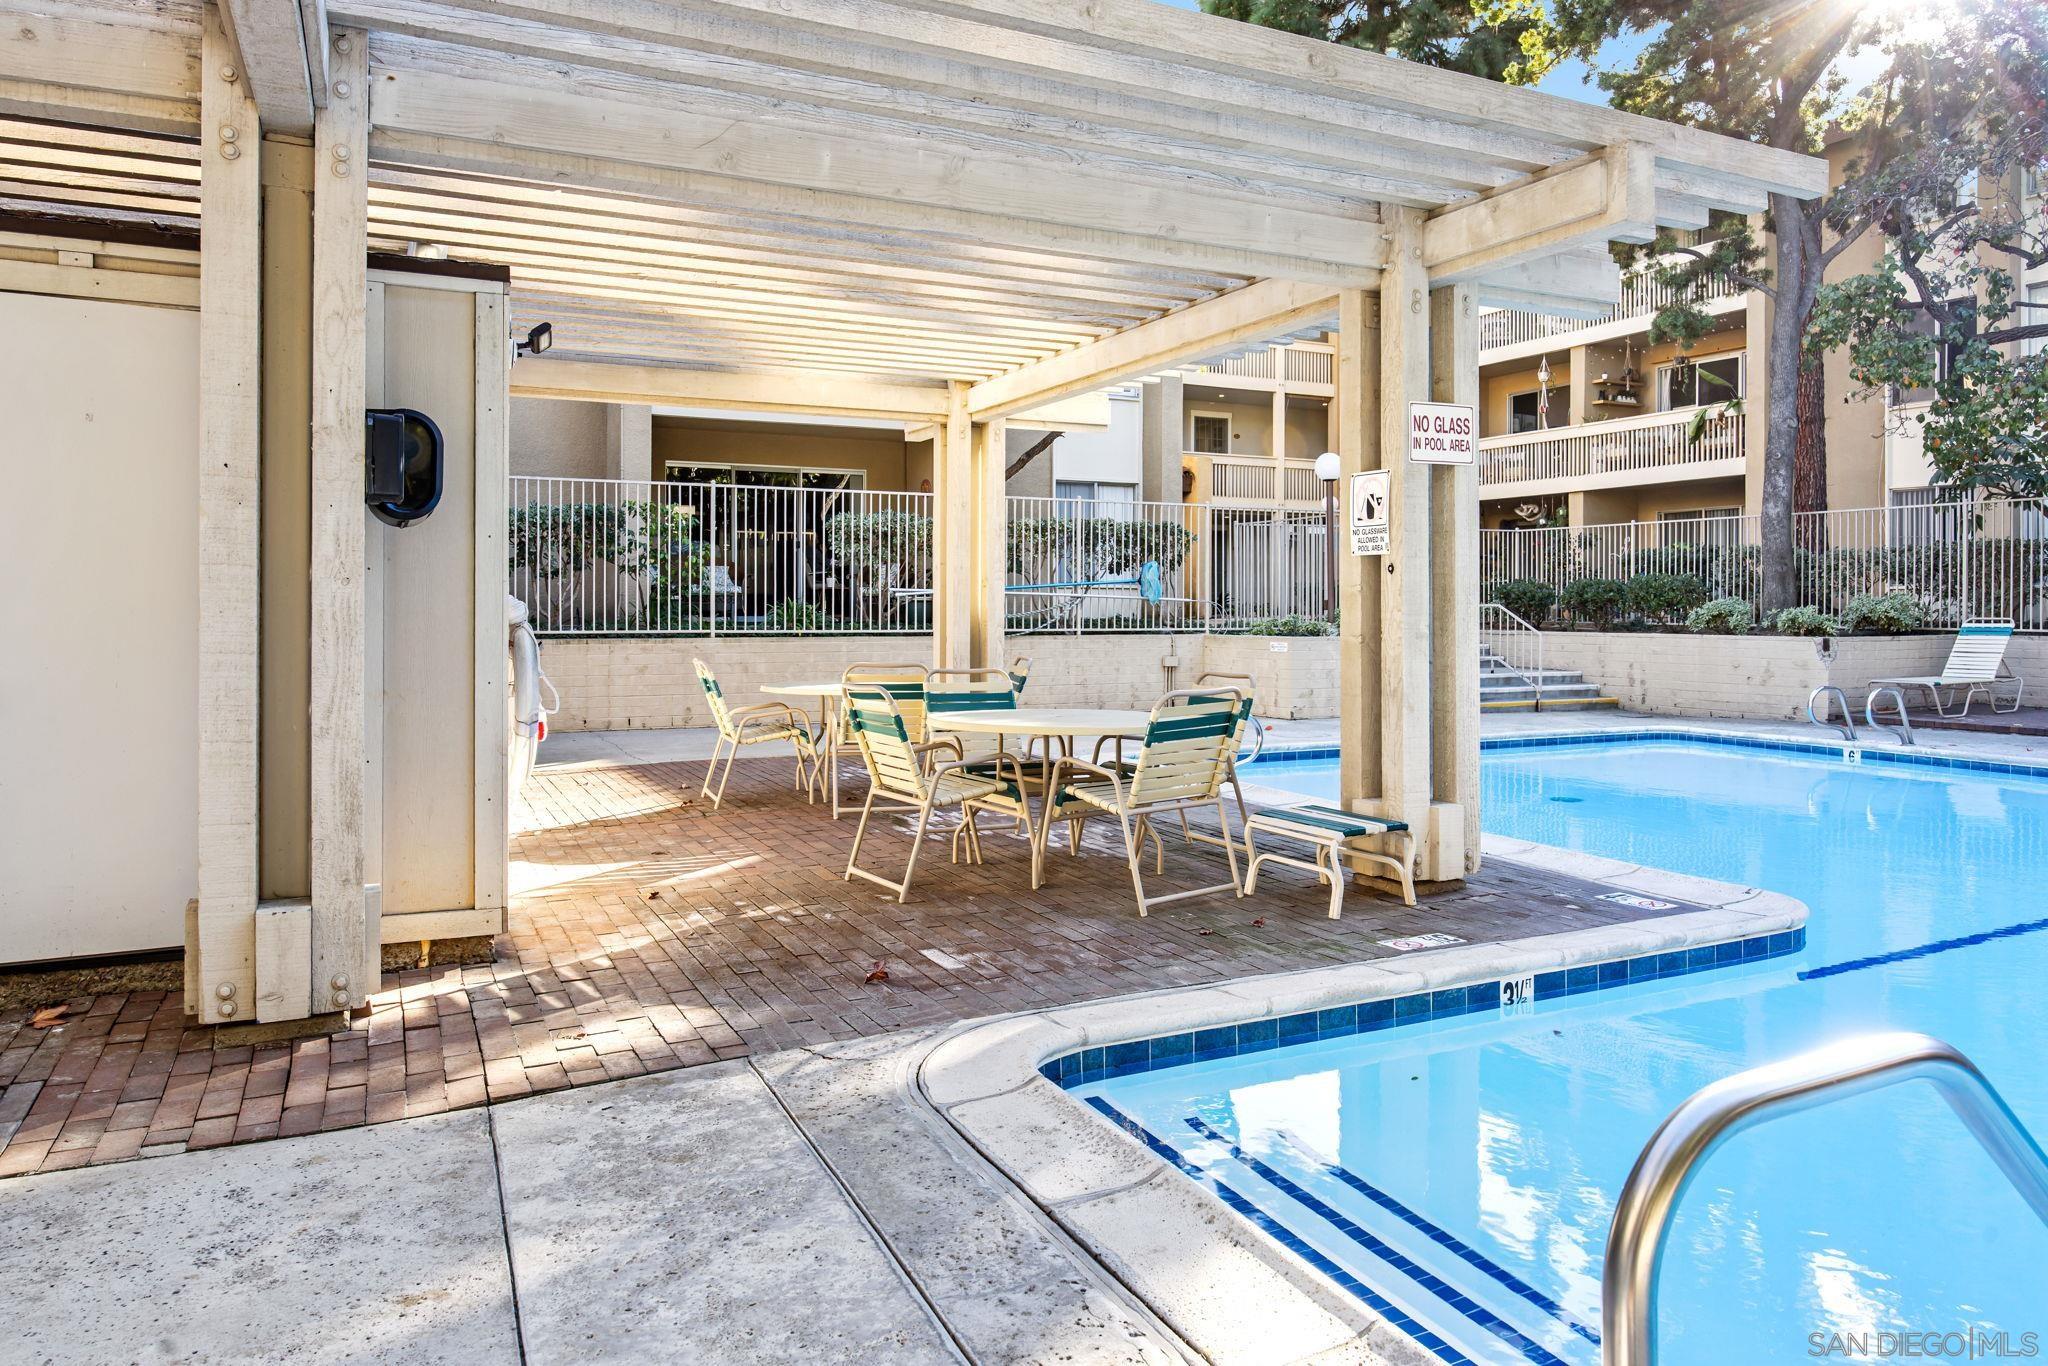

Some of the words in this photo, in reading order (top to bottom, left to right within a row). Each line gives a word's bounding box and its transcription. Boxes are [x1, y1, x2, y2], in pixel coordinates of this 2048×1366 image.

[1413, 415, 1429, 433] NO
[1434, 416, 1471, 435] GLASS
[1413, 437, 1421, 450] IN
[1424, 437, 1447, 451] POOL
[1450, 439, 1471, 452] AREA
[1361, 527, 1388, 536] GLASSWARE
[1357, 536, 1379, 544] ALLOWED
[1371, 544, 1384, 552] AREA
